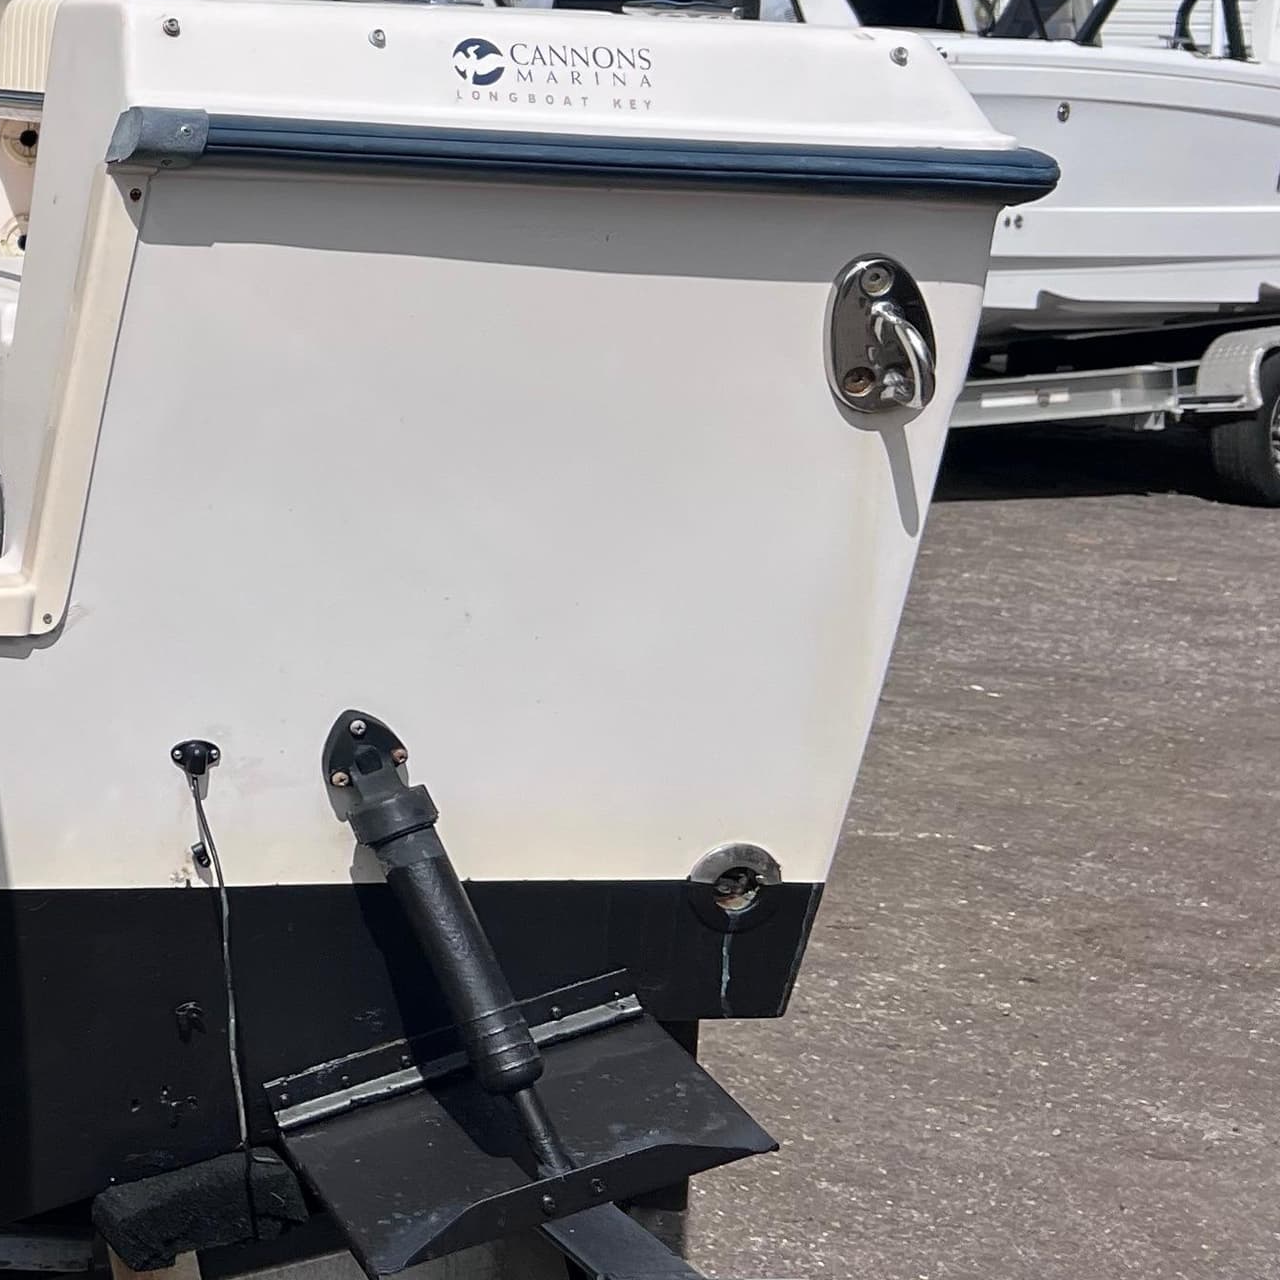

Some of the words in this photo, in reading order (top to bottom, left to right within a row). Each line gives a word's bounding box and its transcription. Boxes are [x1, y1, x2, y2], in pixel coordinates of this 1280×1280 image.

[510, 43, 652, 70] CANNONS
[517, 69, 652, 88] MARINA
[456, 90, 589, 107] LONGBOAT
[613, 98, 652, 110] KEY
